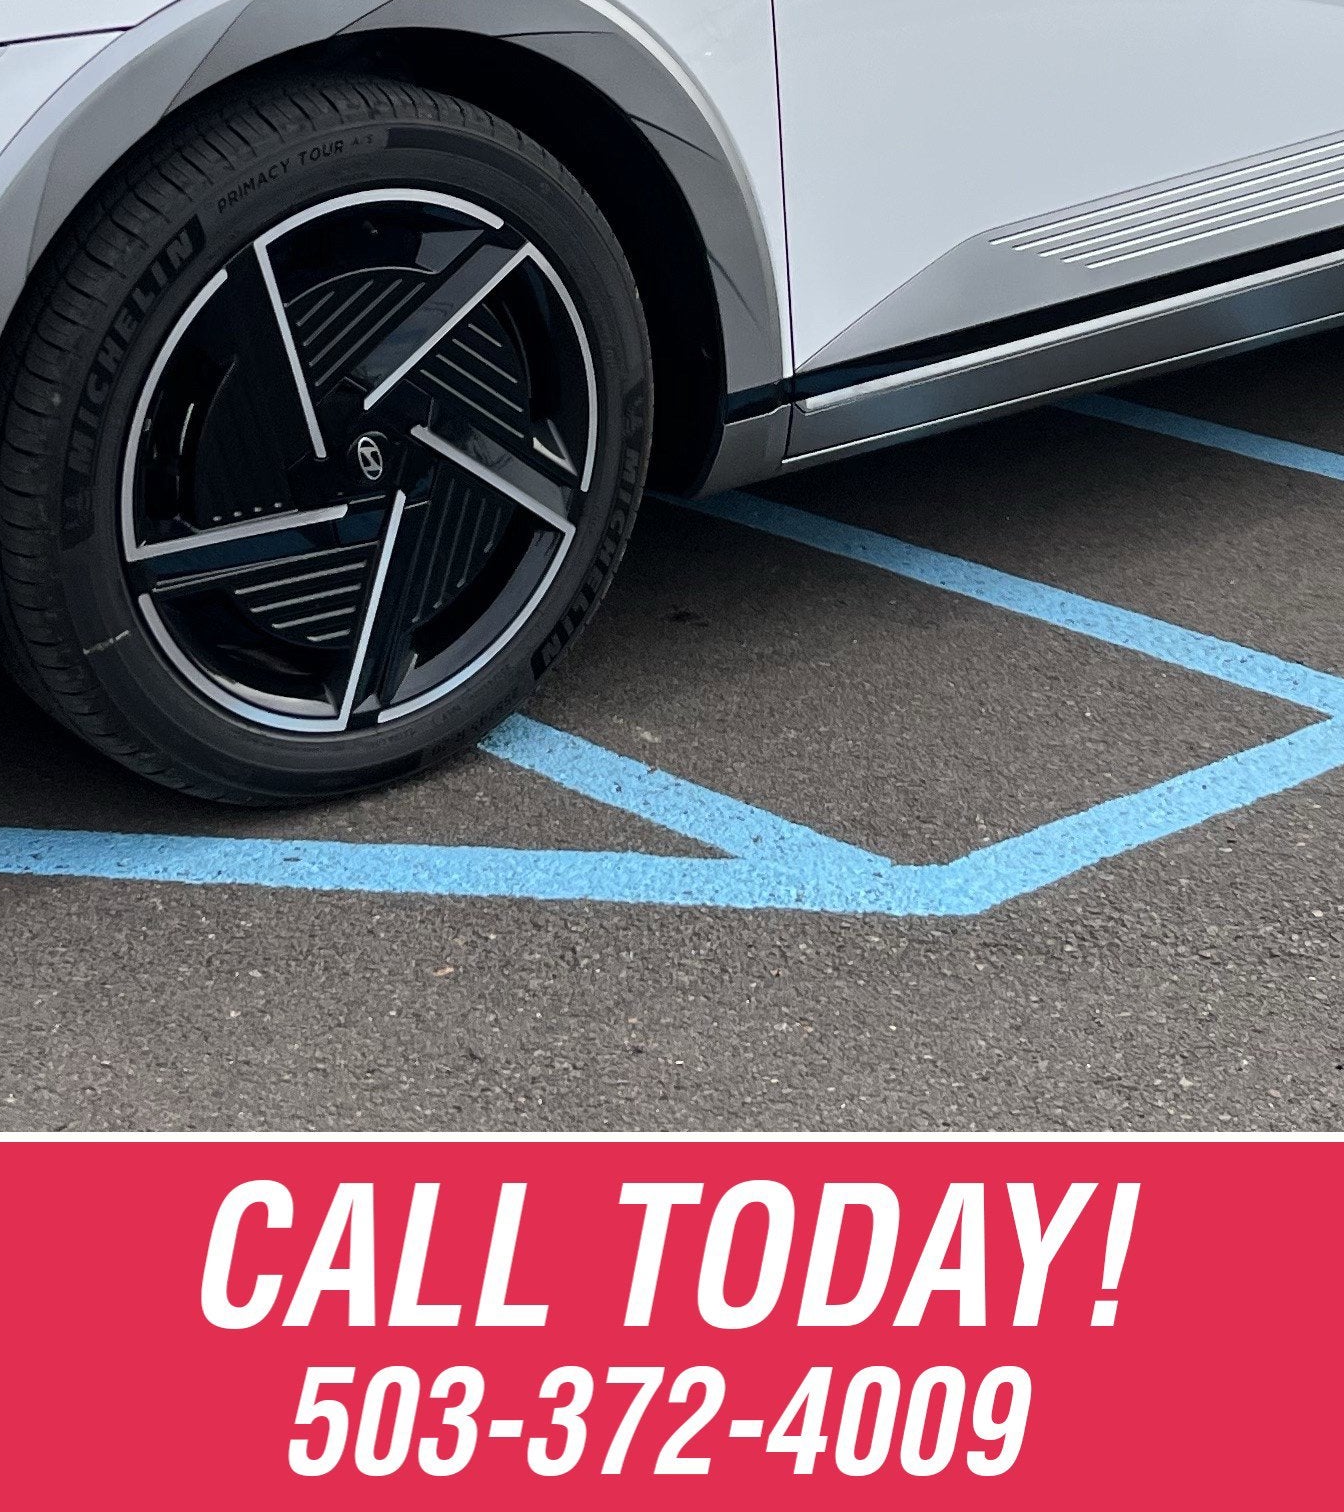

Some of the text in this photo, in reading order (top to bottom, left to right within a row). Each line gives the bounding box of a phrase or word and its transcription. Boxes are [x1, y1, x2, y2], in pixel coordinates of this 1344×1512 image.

[217, 157, 291, 214] PRIMACY
[296, 139, 345, 167] TOUR
[68, 227, 194, 476] MICHELIN
